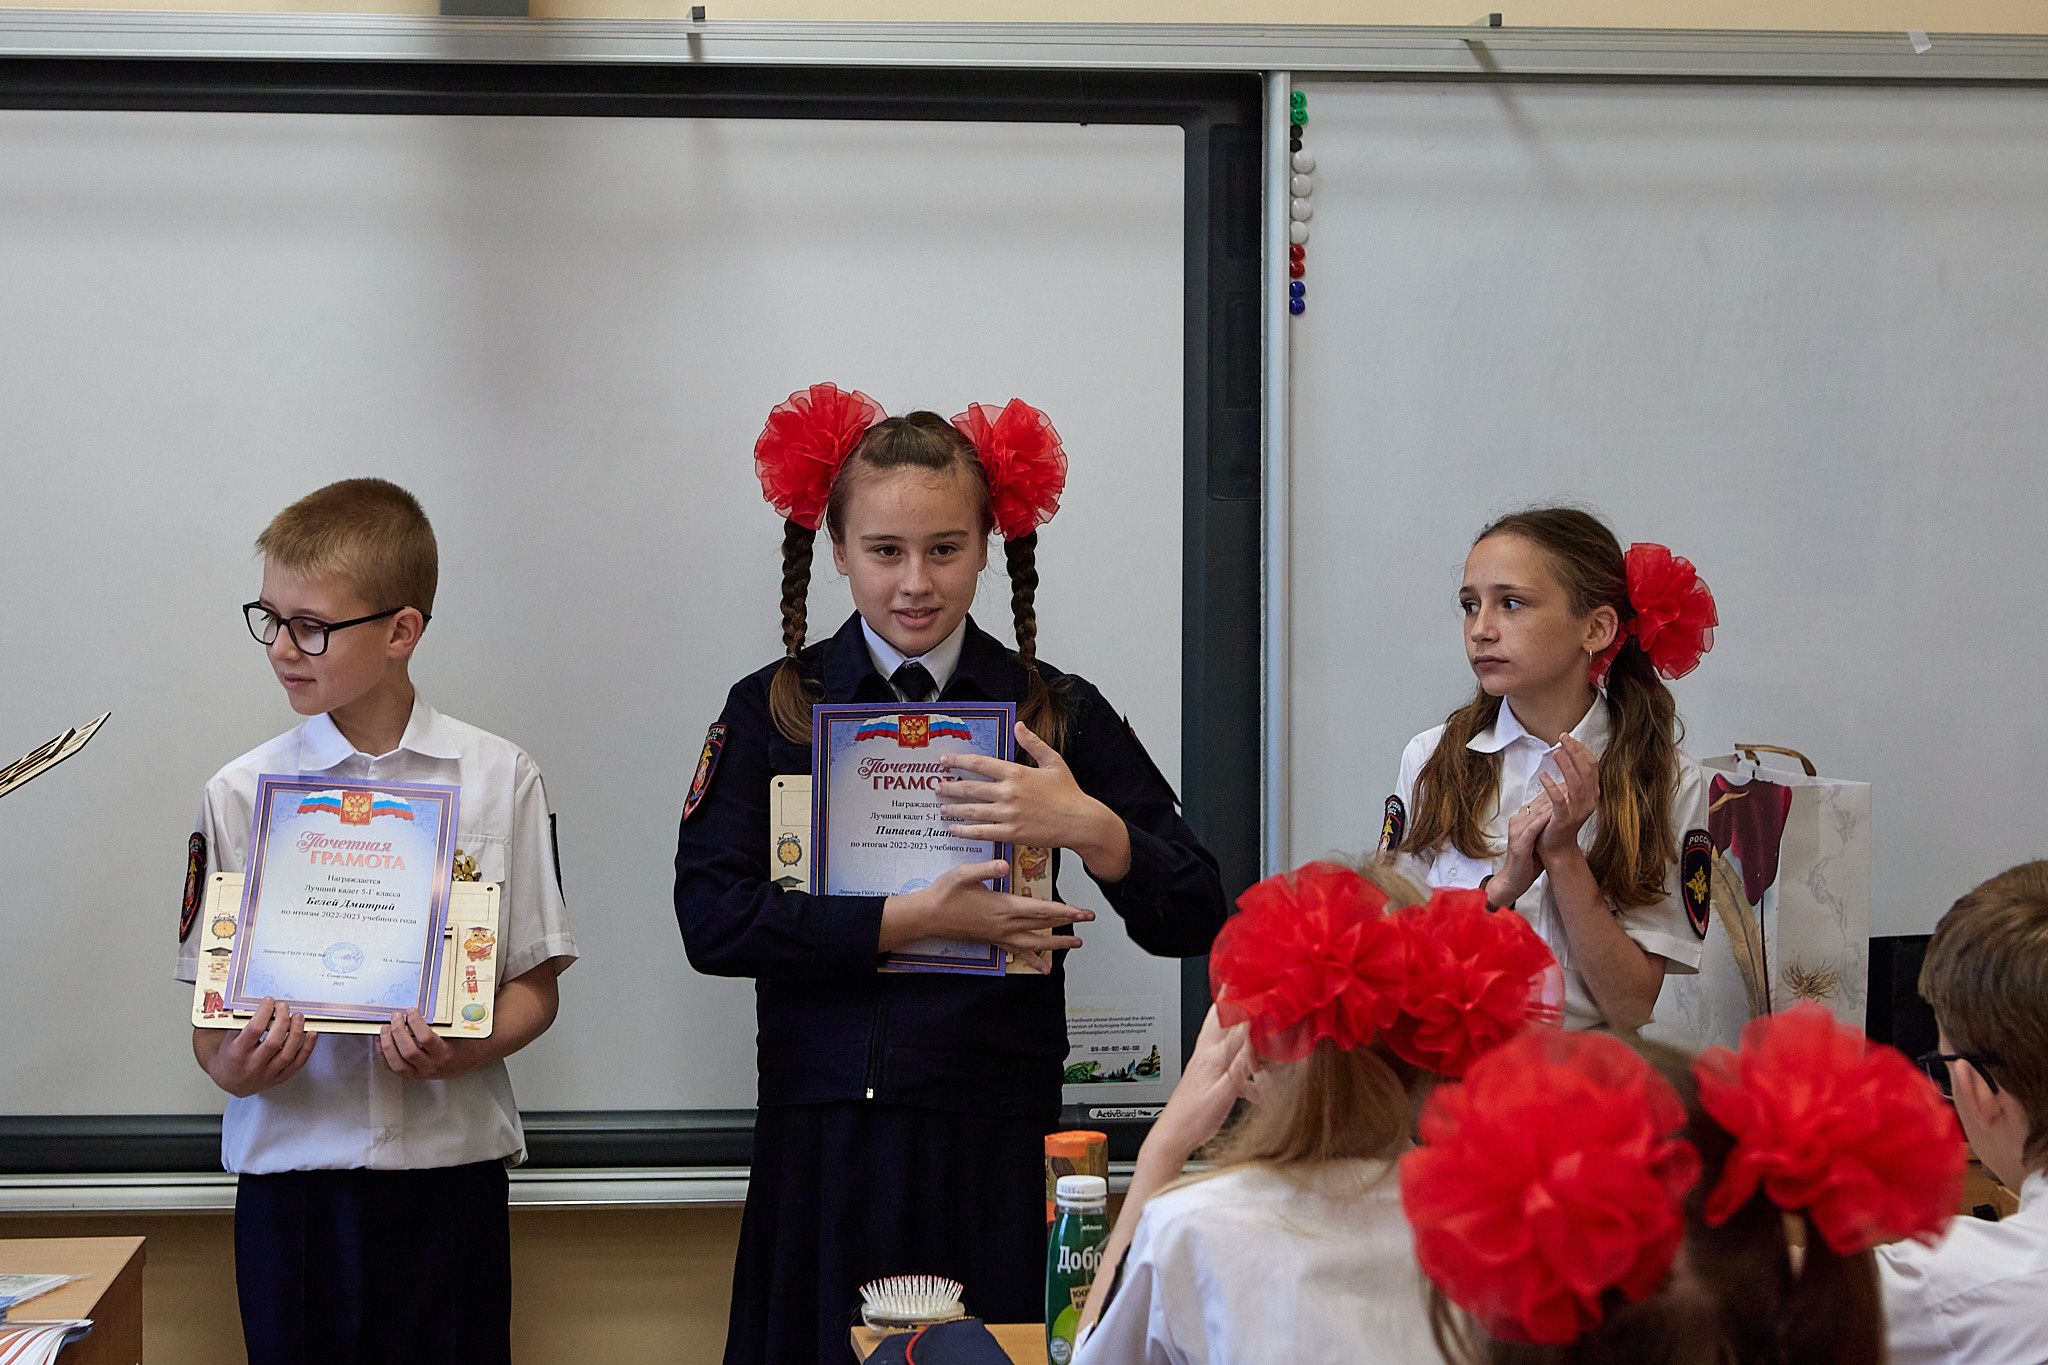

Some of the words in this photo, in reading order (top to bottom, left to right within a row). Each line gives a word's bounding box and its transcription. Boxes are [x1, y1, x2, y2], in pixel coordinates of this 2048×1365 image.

[857, 757, 951, 779] Почетная
[873, 776, 964, 790] ГРАМО
[891, 800, 942, 808] Награждаетс
[870, 812, 902, 821] Лучший
[875, 825, 921, 836] Пипаева
[923, 827, 957, 838] Диан
[296, 831, 392, 853] Почетная
[890, 841, 928, 850] 2022-2023
[929, 844, 964, 853] учебного
[310, 850, 405, 870] ГРАМОТА
[327, 874, 381, 885] Награждается
[304, 884, 336, 894] Лучший
[338, 887, 359, 895] кадет
[376, 890, 401, 898] класса
[306, 897, 339, 907] Белей
[340, 899, 395, 913] Дмитрий
[321, 911, 360, 920] 2022-2023
[362, 915, 398, 924] учебного
[1096, 1109, 1137, 1118] ActivBoard
[1057, 1245, 1103, 1274] Добр
